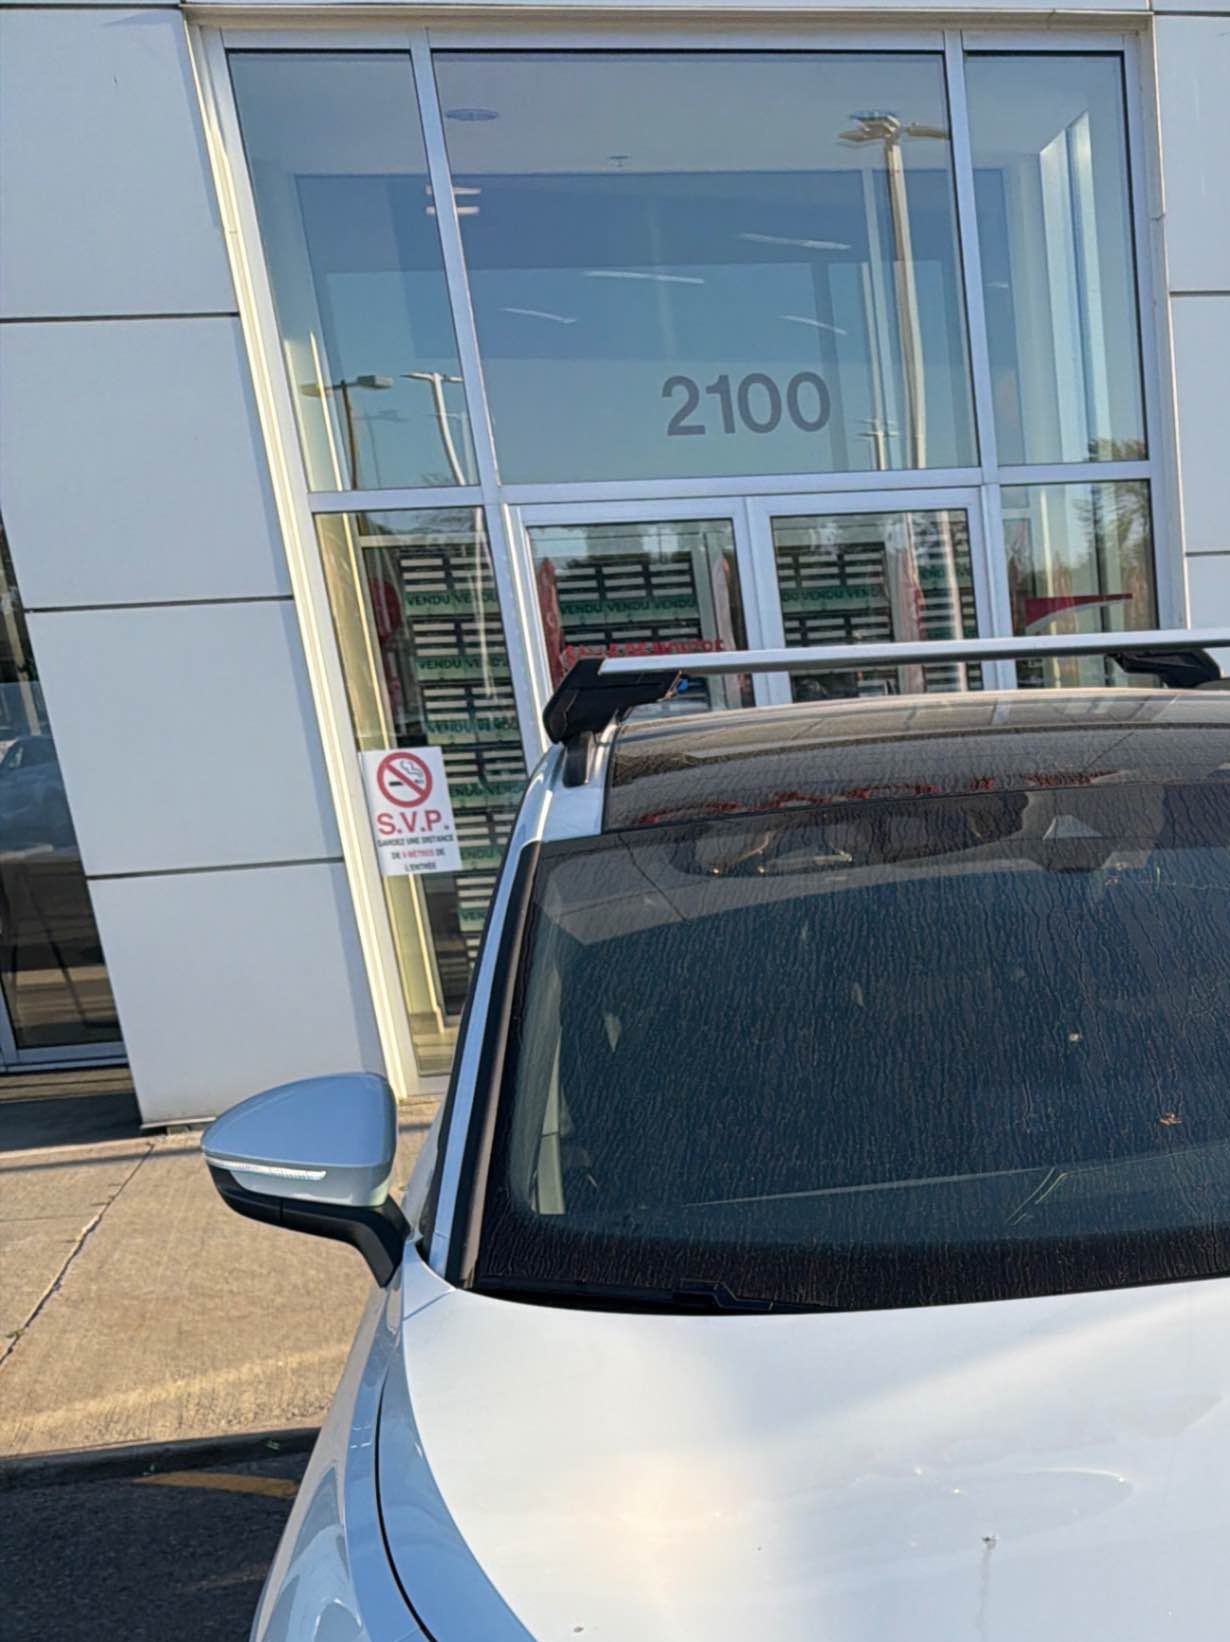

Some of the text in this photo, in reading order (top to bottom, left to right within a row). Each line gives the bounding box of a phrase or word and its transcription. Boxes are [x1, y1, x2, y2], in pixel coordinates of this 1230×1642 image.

[661, 370, 832, 437] 2100
[407, 592, 450, 606] VENDU
[607, 600, 649, 612] VENDU
[419, 658, 462, 671] VENDU
[377, 809, 450, 835] S.V.P.
